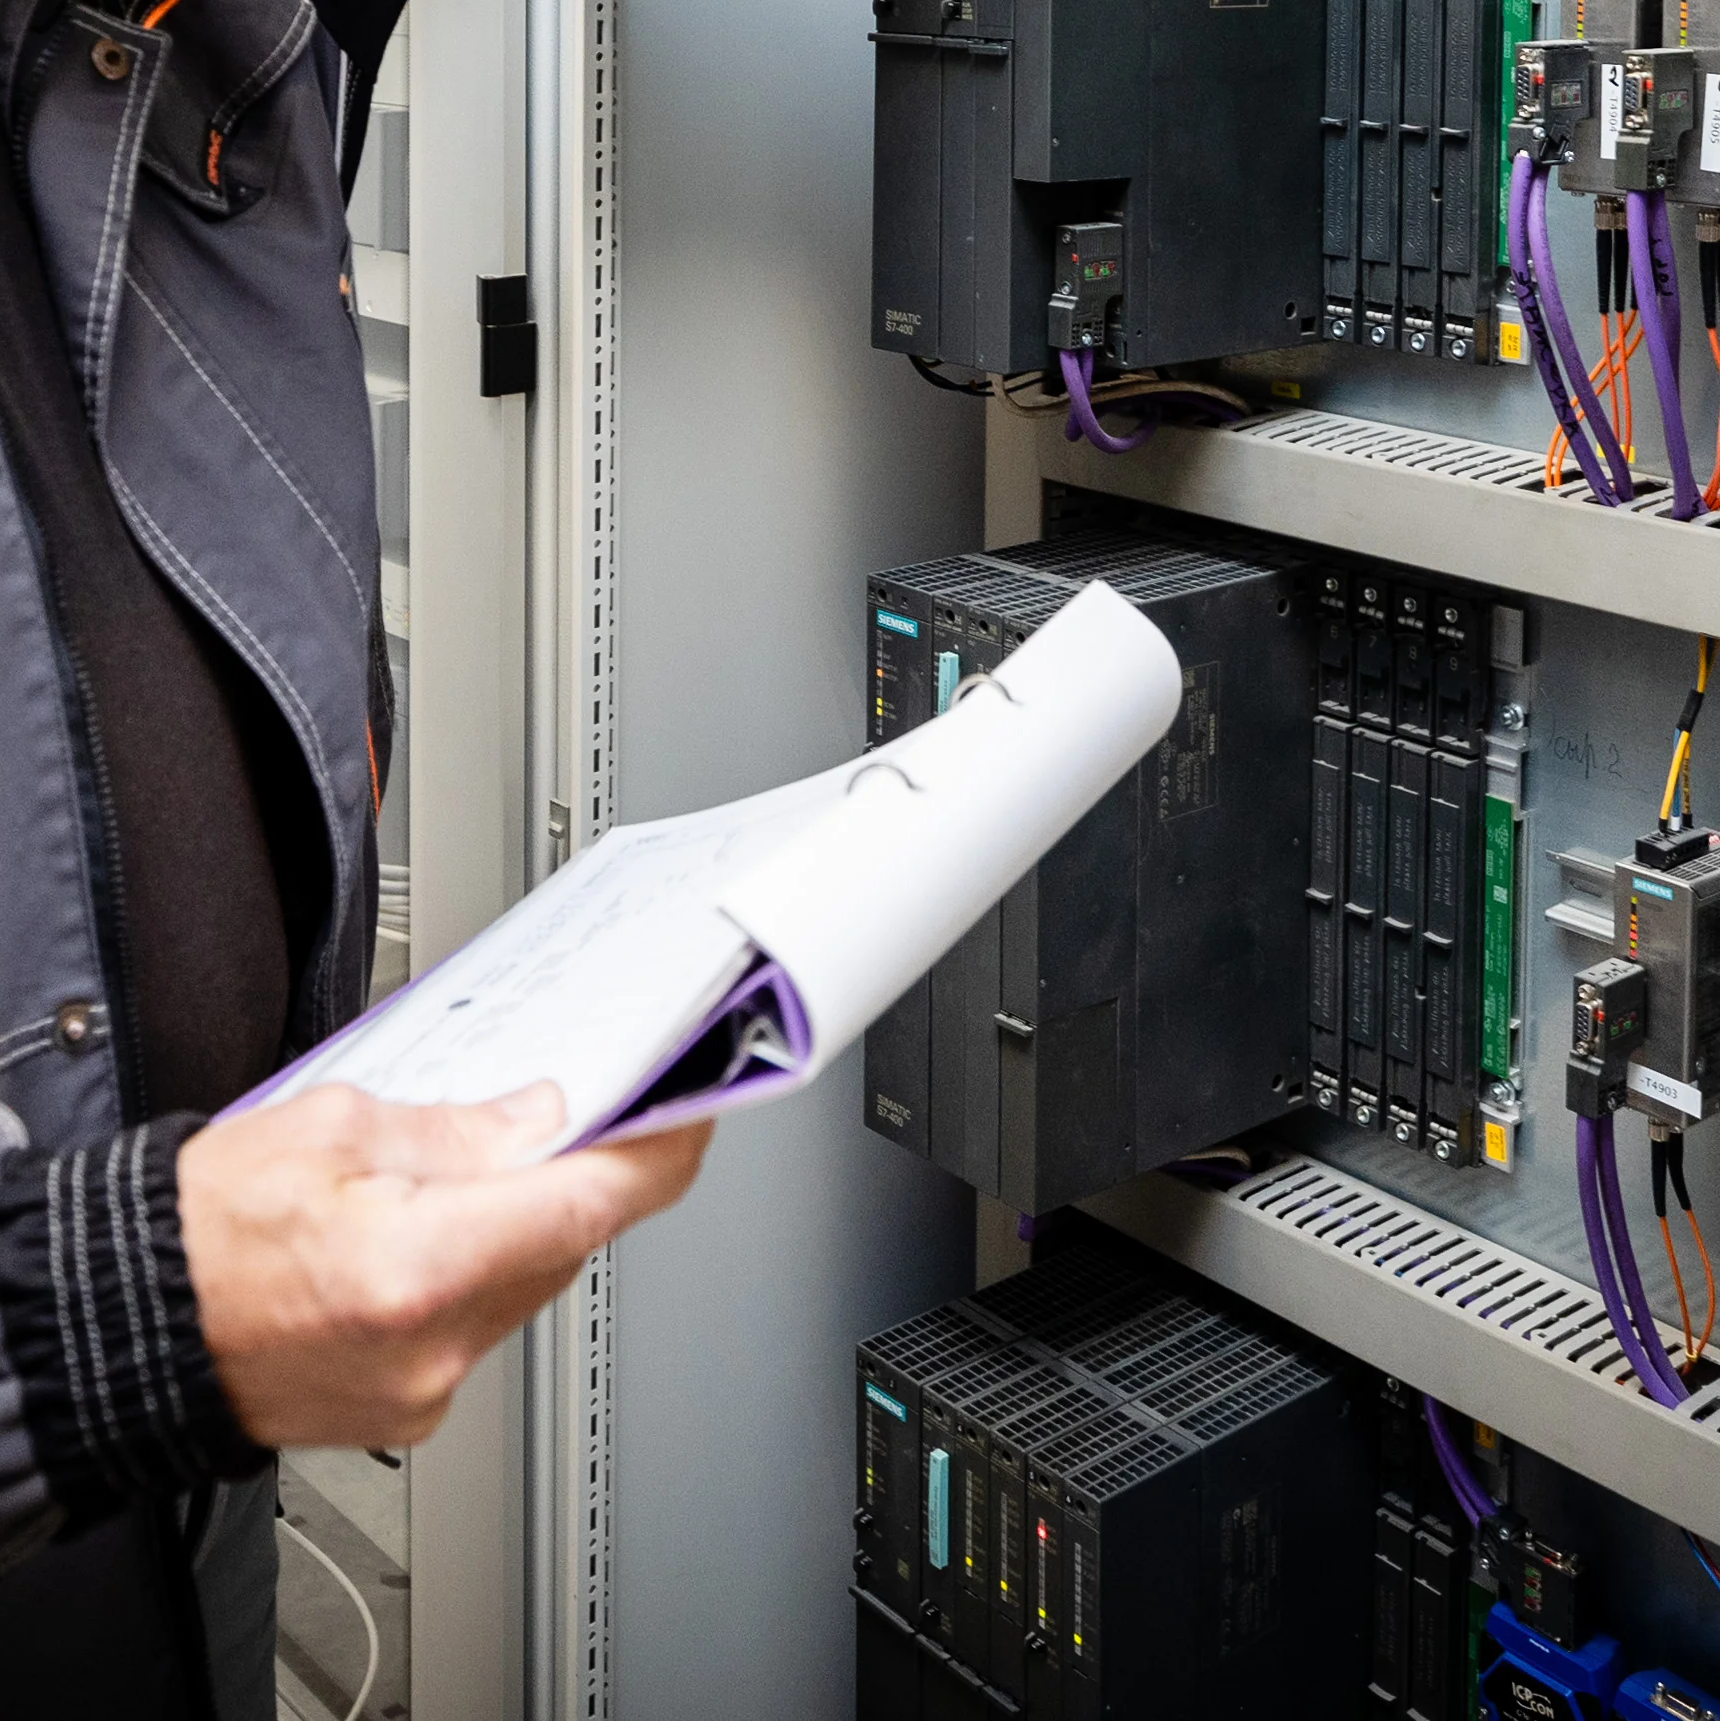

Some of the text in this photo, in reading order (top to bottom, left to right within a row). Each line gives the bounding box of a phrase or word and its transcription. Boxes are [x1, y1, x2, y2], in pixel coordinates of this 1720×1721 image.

[885, 309, 922, 325] SIMATIC
[885, 321, 913, 336] S7-400
[878, 612, 915, 634] SIEMENS
[1634, 878, 1672, 899] SIEMENS
[1639, 1077, 1678, 1100] -T4903
[876, 1093, 912, 1121] SIMATIC
[876, 1104, 904, 1128] S7-400
[1511, 1681, 1533, 1702] ICP
[1530, 1700, 1555, 1720] CON
